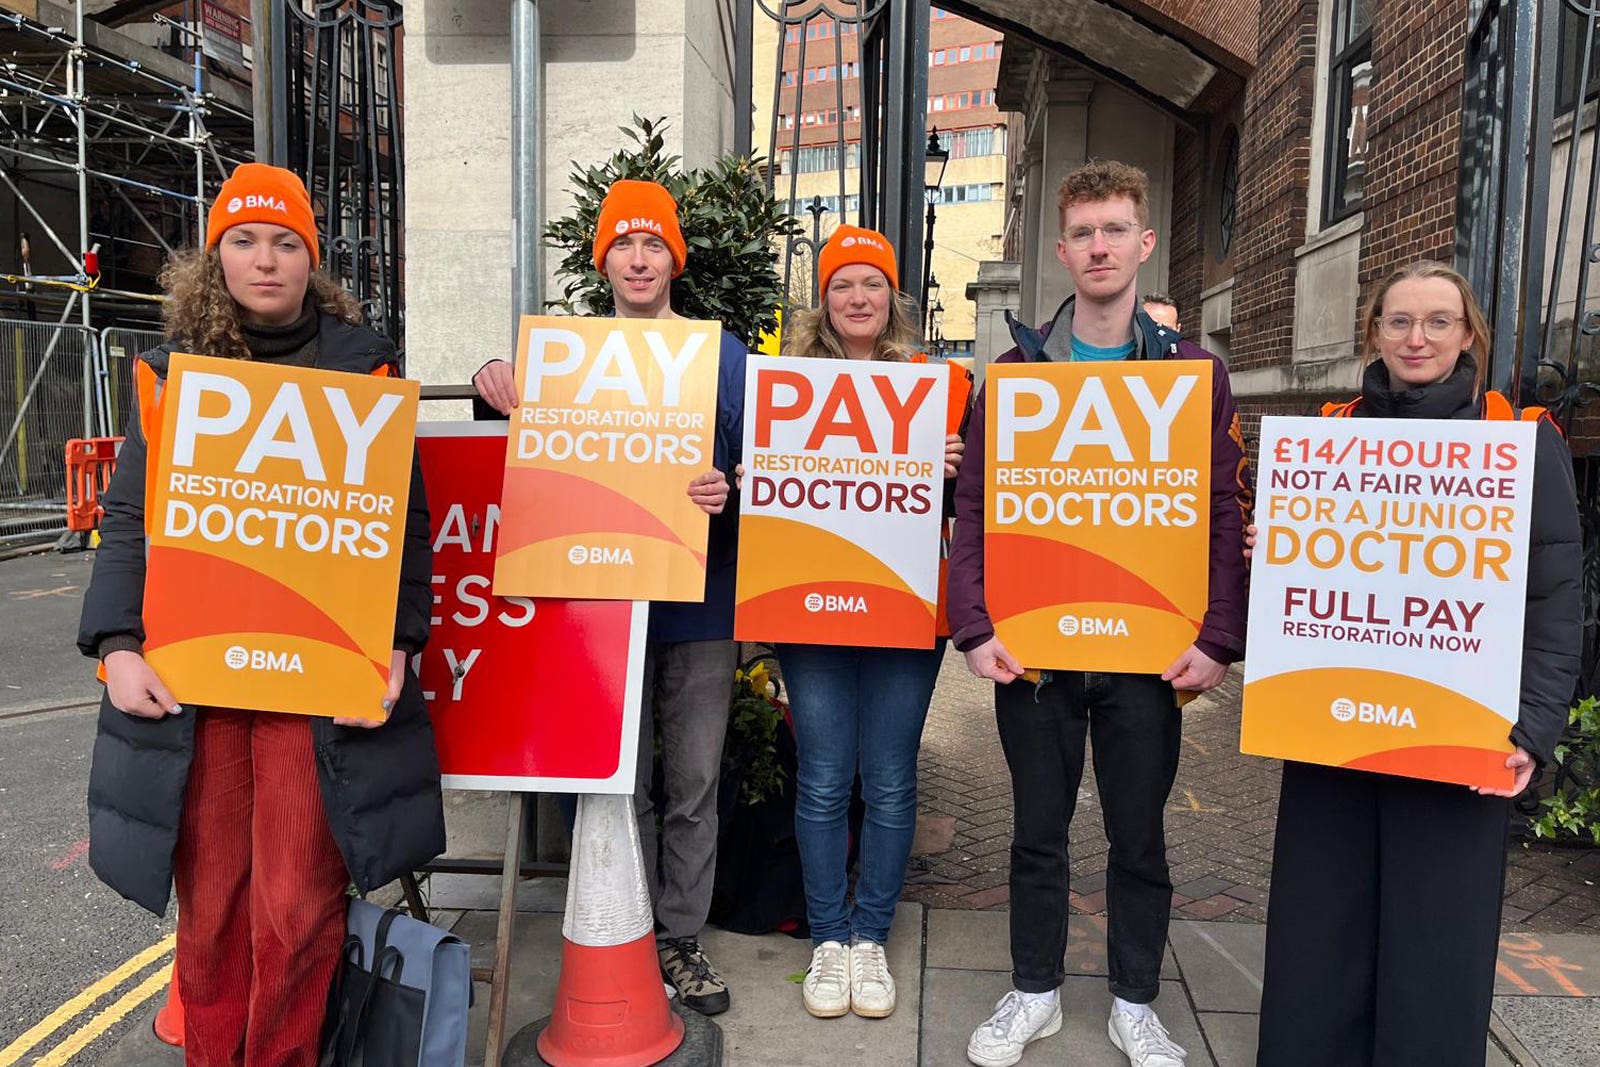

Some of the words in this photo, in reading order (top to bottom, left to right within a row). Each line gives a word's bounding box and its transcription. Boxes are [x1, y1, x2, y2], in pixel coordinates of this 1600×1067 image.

[203, 3, 239, 30] WARNING
[246, 195, 287, 214] BMA
[631, 218, 662, 233] BMA
[857, 237, 884, 251] BMA
[522, 328, 708, 406] PAY
[172, 371, 404, 485] PAY
[521, 408, 660, 427] RESTORATION
[665, 412, 705, 429] FOR
[754, 369, 937, 454] PAY
[997, 375, 1199, 462] PAY
[517, 429, 702, 465] DOCTORS
[1273, 436, 1471, 470] £14/HOUR
[1482, 442, 1518, 471] IS
[753, 454, 889, 476] RESTORATION
[894, 460, 933, 478] FOR
[996, 467, 1148, 486] RESTORATION
[1153, 468, 1198, 487] FOR
[169, 472, 341, 509] RESTORATION
[345, 491, 394, 516] FOR
[751, 476, 932, 515] DOCTORS
[1271, 469, 1326, 490] NOT
[1333, 472, 1352, 492] A
[1360, 473, 1422, 495] FAIR
[1429, 475, 1515, 500] WAGE
[996, 491, 1198, 527] DOCTORS
[1268, 495, 1337, 523] FOR
[1344, 499, 1369, 525] A
[1375, 500, 1515, 533] JUNIOR
[164, 500, 391, 559] DOCTORS
[589, 549, 634, 565] BMA
[1265, 525, 1513, 582] DOCTOR
[825, 596, 868, 613] BMA
[1284, 586, 1391, 626] FULL
[1403, 596, 1485, 633] PAY
[1081, 617, 1129, 637] BMA
[1283, 621, 1424, 648] RESTORATION
[1429, 634, 1482, 654] NOW
[250, 650, 304, 674] BMA
[1359, 703, 1417, 729] BMA
